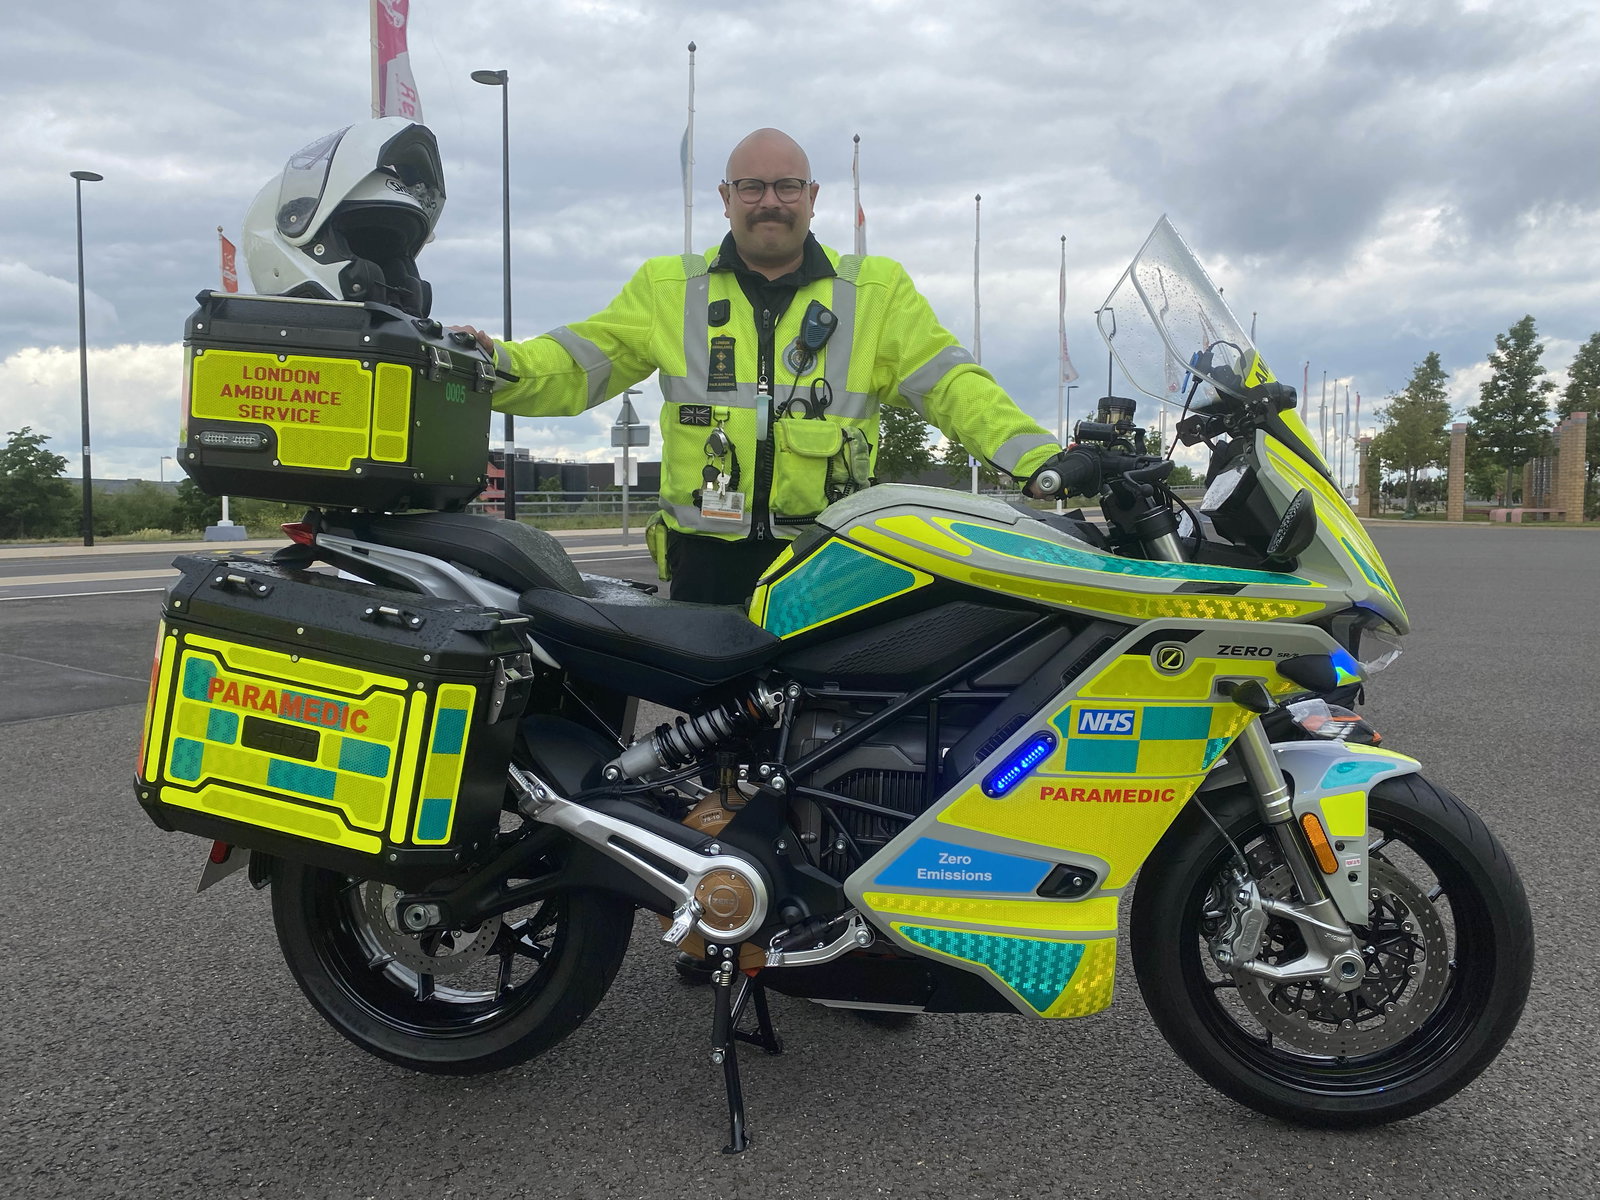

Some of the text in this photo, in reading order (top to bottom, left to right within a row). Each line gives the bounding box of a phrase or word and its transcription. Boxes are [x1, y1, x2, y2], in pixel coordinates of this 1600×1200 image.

[242, 365, 320, 385] LONDON
[220, 383, 342, 406] AMBULANCE
[445, 382, 466, 404] 0005
[238, 404, 321, 424] SERVICE
[1216, 644, 1274, 657] ZERO
[207, 677, 369, 734] PARAMEDIC
[1079, 712, 1134, 732] NHS
[1039, 786, 1176, 803] PARAMEDIC
[938, 852, 972, 865] Zero
[916, 867, 993, 881] Emissions
